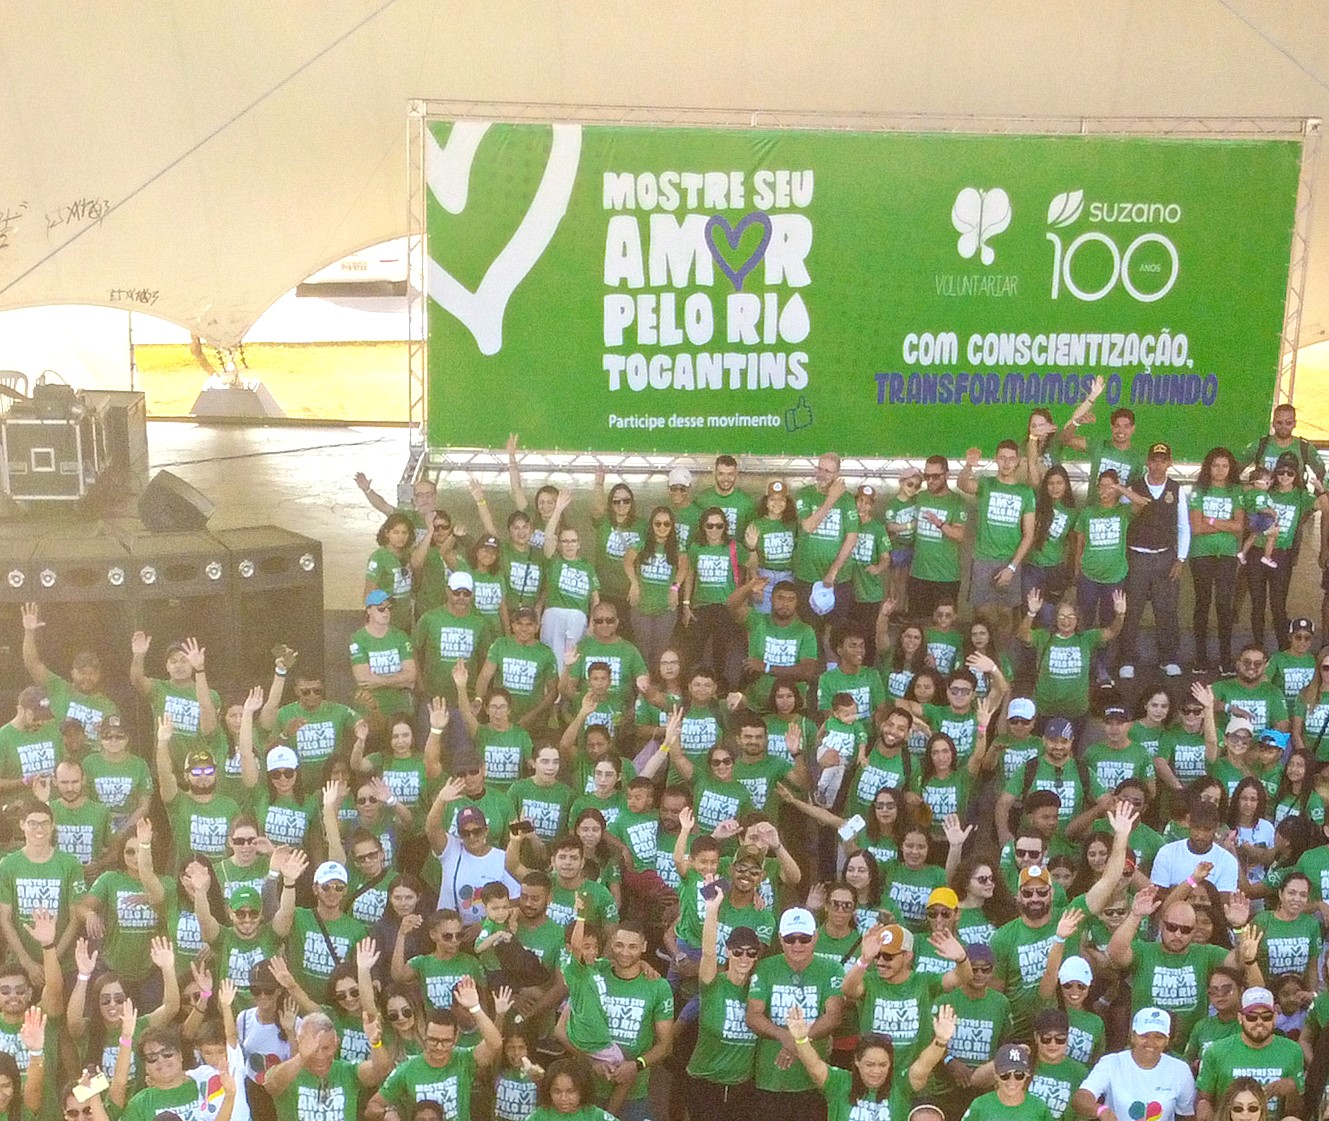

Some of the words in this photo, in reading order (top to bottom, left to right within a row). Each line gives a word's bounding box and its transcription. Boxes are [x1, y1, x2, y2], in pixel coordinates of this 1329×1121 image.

[603, 171, 745, 210] MOSTRE
[753, 170, 814, 209] SEU
[1088, 202, 1181, 224] suzano
[603, 211, 813, 291] AMOR
[1046, 232, 1179, 302] 100
[935, 274, 1018, 298] VOLUNTARIAR
[603, 292, 714, 347] PELO
[727, 292, 810, 345] RIO
[603, 351, 809, 391] TOCANTINS
[902, 332, 958, 366] COM
[966, 327, 1194, 375] CONSCIENTIZAÇÃO,
[874, 372, 1095, 405] TRANSFORMAMOS
[1106, 373, 1122, 405] O
[1130, 373, 1218, 407] MUNDO
[608, 414, 666, 431] Participe
[668, 414, 704, 428] desse
[707, 412, 781, 427] movimento
